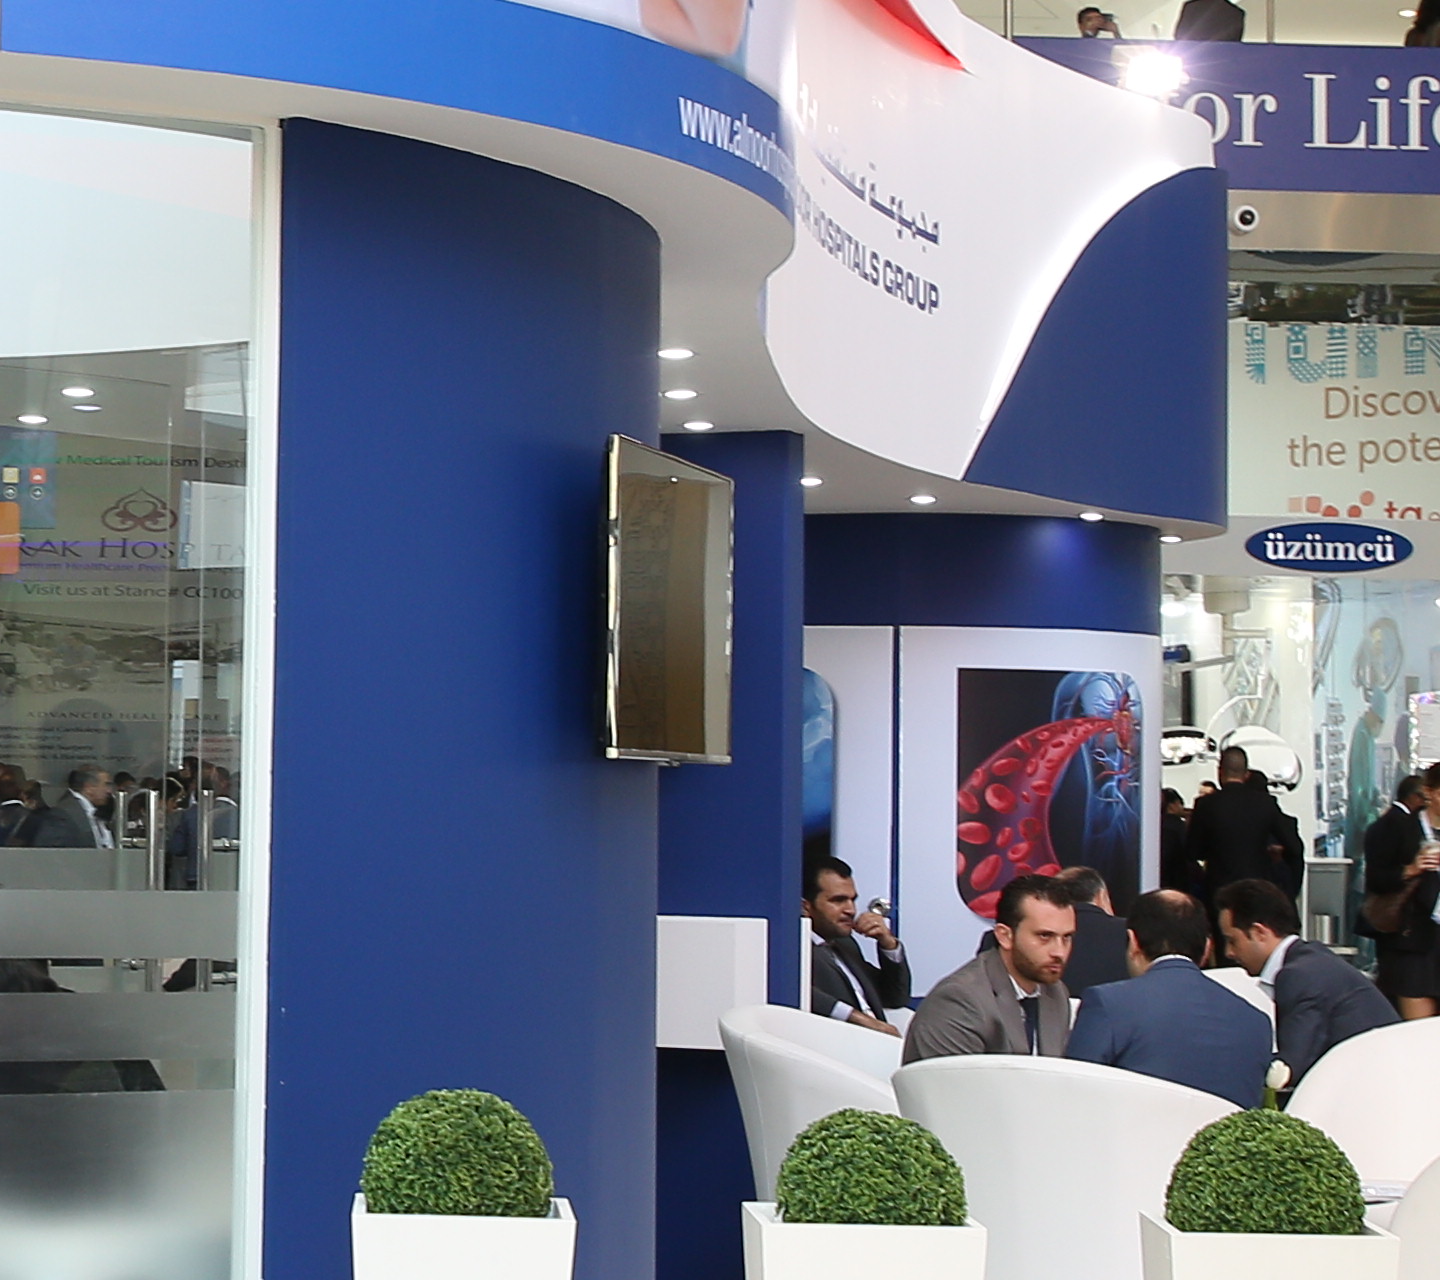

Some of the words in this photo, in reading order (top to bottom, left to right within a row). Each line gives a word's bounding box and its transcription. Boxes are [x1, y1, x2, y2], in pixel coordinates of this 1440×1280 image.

[1182, 82, 1278, 148] or
[882, 259, 940, 316] GROUP
[1288, 435, 1346, 467] the
[1264, 533, 1395, 562] üzümcü
[24, 583, 61, 597] Visit
[67, 586, 87, 597] us
[92, 585, 108, 597] at
